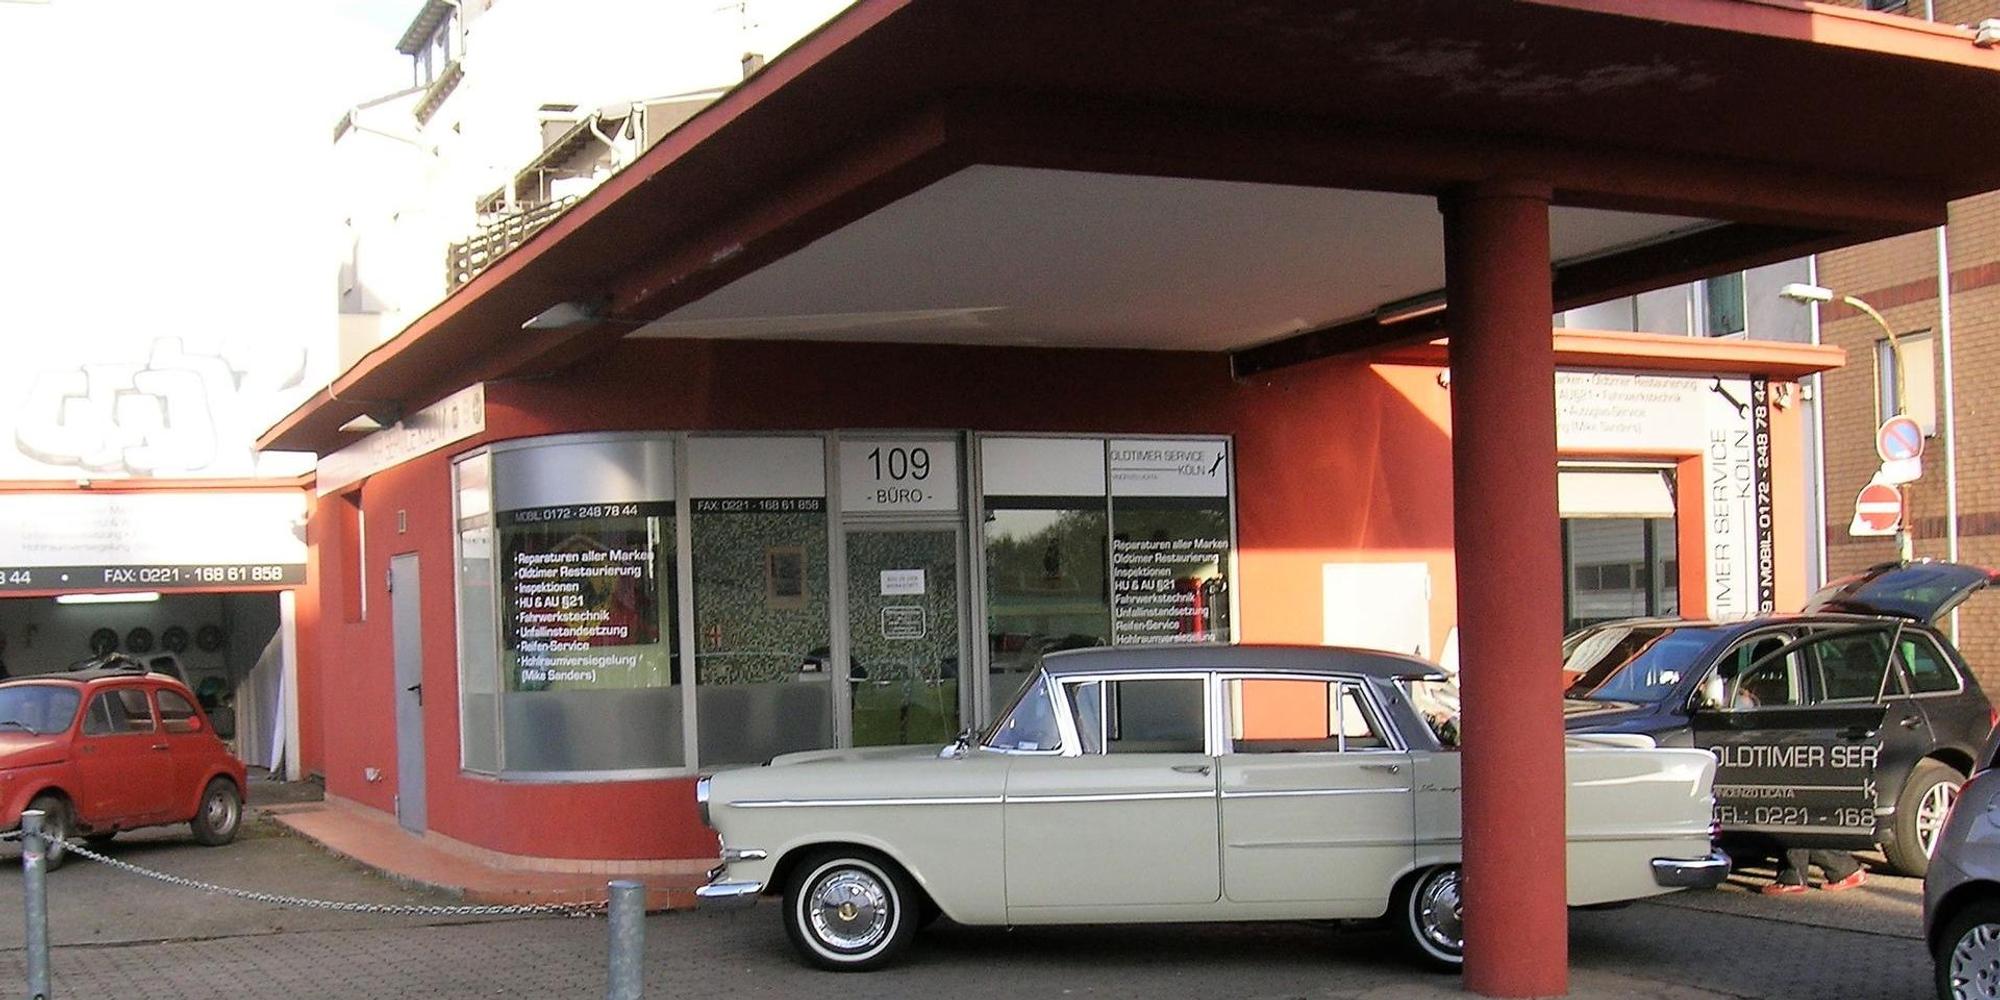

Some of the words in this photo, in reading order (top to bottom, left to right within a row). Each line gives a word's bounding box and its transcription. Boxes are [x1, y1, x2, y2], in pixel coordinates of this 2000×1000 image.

[1753, 380, 1766, 402] 44
[1756, 405, 1767, 430] 78
[1110, 450, 1161, 461] OLDTIMER
[1164, 450, 1204, 461] SERVICE
[1756, 433, 1769, 468] 248
[868, 447, 930, 480] 109
[1711, 428, 1729, 534] SERVICE
[876, 486, 923, 503] BÜRO
[543, 507, 571, 519] 0172
[578, 506, 601, 518] 248
[604, 505, 620, 517] 78
[621, 504, 638, 516] 44
[697, 500, 720, 511] FAX:
[721, 500, 749, 511] 0221
[759, 500, 780, 511] 168
[782, 500, 795, 511] 61
[798, 500, 819, 511] 858
[1758, 481, 1771, 528] 0172
[1112, 540, 1171, 552] Reparaturen
[1193, 538, 1229, 550] Marken
[518, 552, 580, 566] Reparaturen
[581, 550, 607, 562] aller
[609, 548, 654, 562] Marken
[1113, 552, 1154, 564] Oldtimer
[1155, 552, 1219, 565] Restaurierung
[1760, 531, 1773, 587] MOBIL:
[9, 571, 31, 585] 44
[104, 568, 137, 583] FAX:
[140, 568, 179, 582] 0221
[194, 567, 224, 582] 168
[227, 567, 246, 582] 61
[252, 566, 283, 581] 858
[518, 567, 560, 580] Oldtimer
[560, 564, 642, 579] Restaurierung
[1114, 566, 1172, 579] Inspektionen
[518, 582, 580, 595] Inspektionen
[1115, 579, 1130, 591] HU
[1140, 579, 1155, 591] AU
[519, 597, 533, 609] HU
[543, 596, 559, 608] AU
[1115, 592, 1196, 605] Fahrwerkstechnik
[519, 609, 610, 623] Fahrwerkstechnik
[1115, 606, 1210, 618] Unfallinstandsetzung
[520, 625, 629, 639] Unfallinstandsetzung
[520, 640, 590, 652] Reifen-Service
[520, 653, 637, 668] Hohlraumversiegelung
[521, 669, 546, 683] (Mike
[547, 669, 596, 683] Sanders)
[1709, 745, 1825, 768] OLDTIMER
[1831, 741, 1883, 769] SER
[1755, 806, 1809, 825] 0221
[1834, 807, 1877, 827] 168
